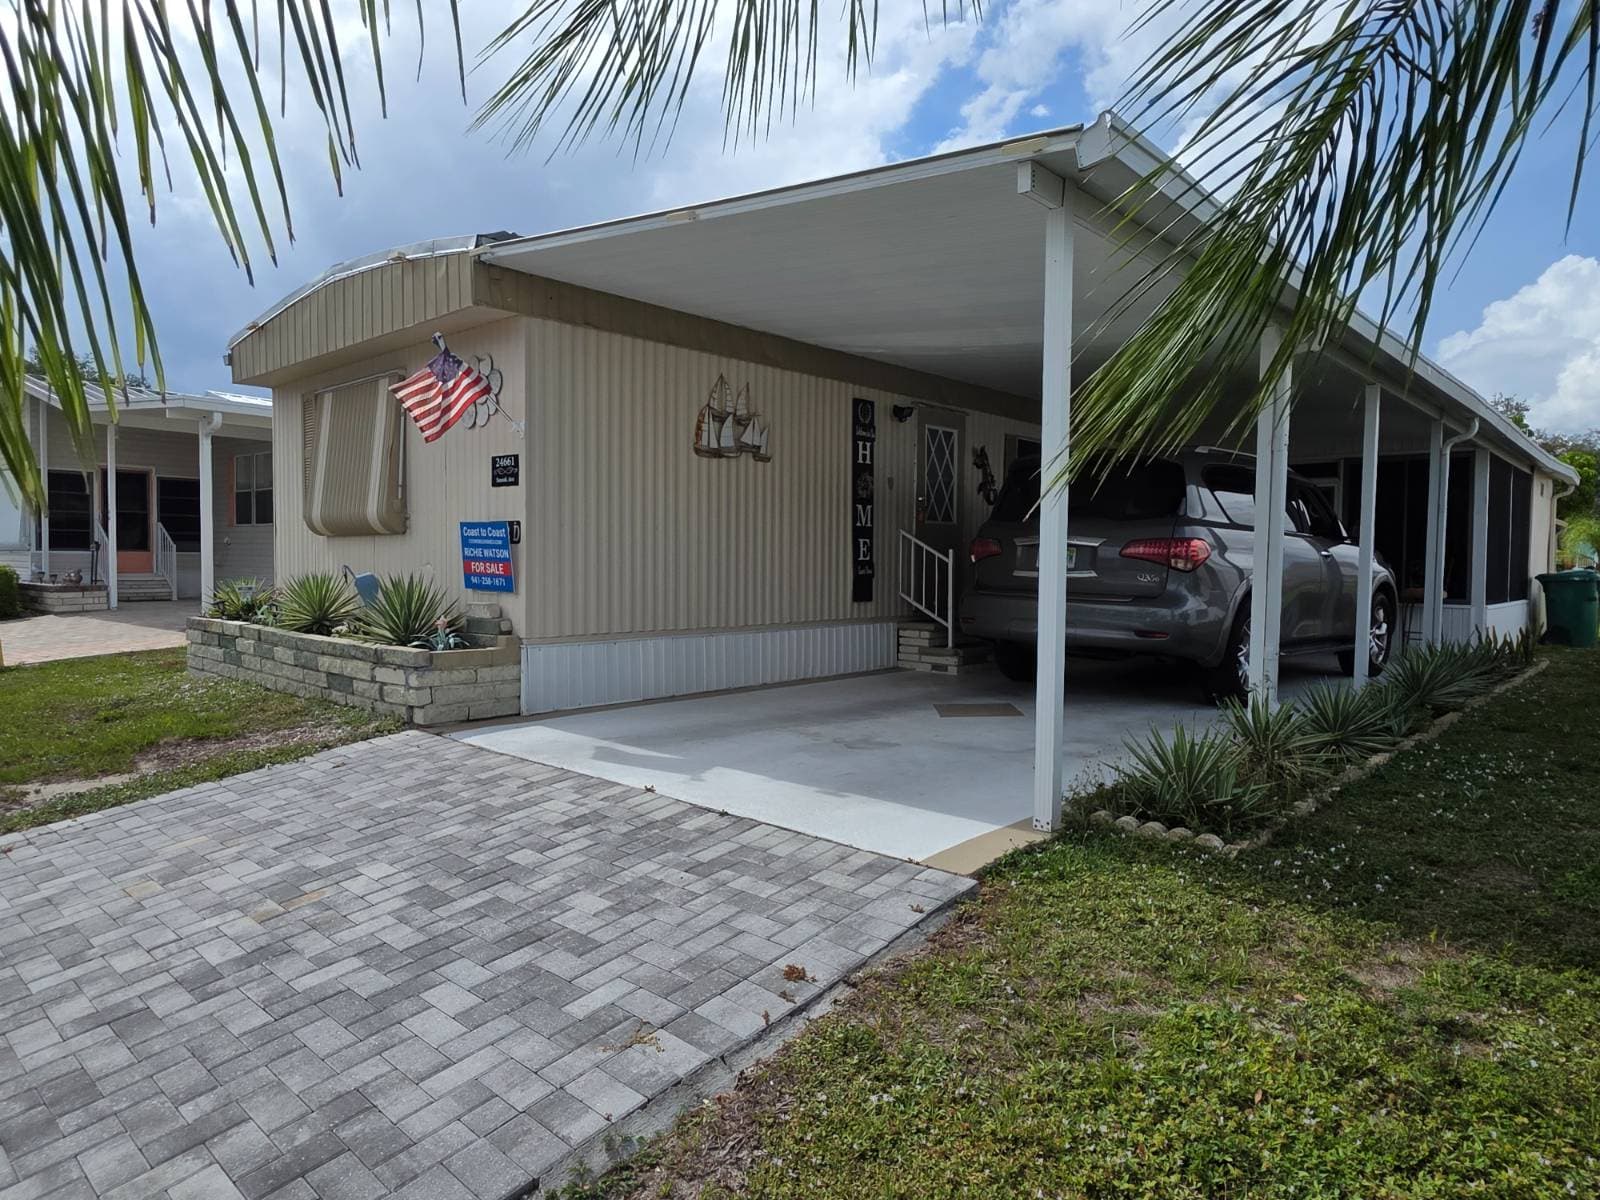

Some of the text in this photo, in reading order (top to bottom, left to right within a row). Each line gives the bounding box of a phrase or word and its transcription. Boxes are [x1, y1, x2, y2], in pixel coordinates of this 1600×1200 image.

[495, 456, 514, 467] 24661
[463, 526, 506, 537] Coast to Coast
[464, 548, 509, 558] RICHIE WATSON
[471, 562, 505, 574] FOR SALE
